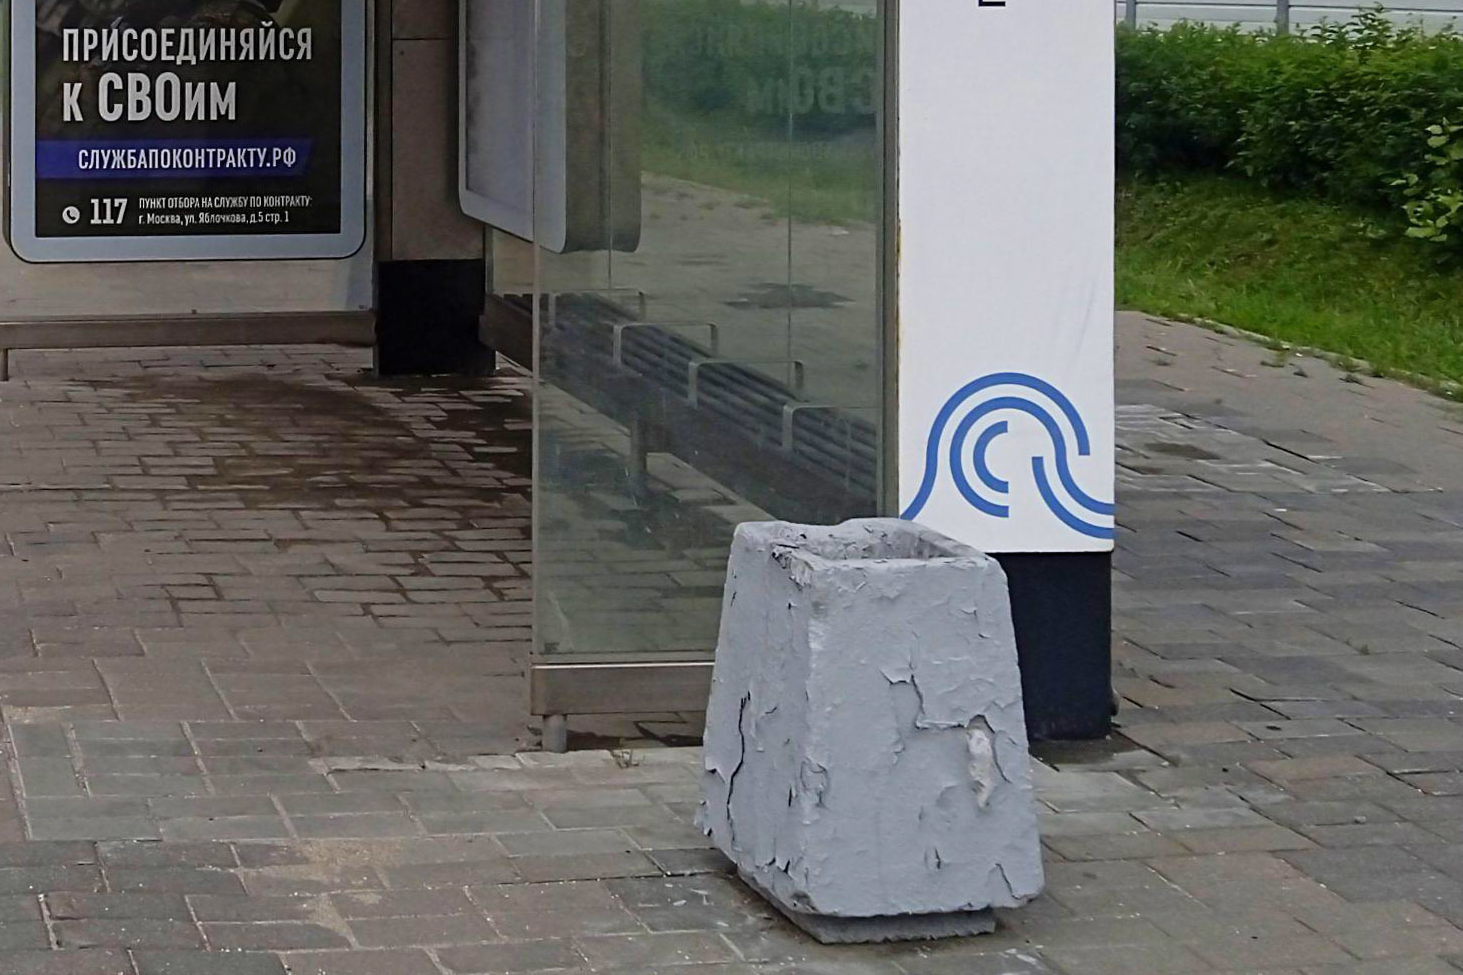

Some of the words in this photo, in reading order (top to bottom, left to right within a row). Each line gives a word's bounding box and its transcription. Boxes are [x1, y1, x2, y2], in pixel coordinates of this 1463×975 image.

[62, 20, 313, 66] ПРИСОЕДИНЯЙСЯ
[78, 146, 297, 170] СЛУЖБАПОКОНТРАКТУ.РФ
[90, 198, 128, 225] 117
[139, 197, 166, 209] ПУНКТ
[167, 197, 200, 209] ОТБОРА
[201, 196, 213, 208] НА
[214, 196, 248, 208] СЛУЖБУ
[249, 196, 262, 207] ПО
[138, 214, 145, 225] г.
[147, 212, 183, 226] Москва,
[185, 214, 197, 227] ул.
[198, 211, 249, 224] Яблочкова,
[265, 213, 283, 225] стр.
[284, 211, 289, 223] 1
